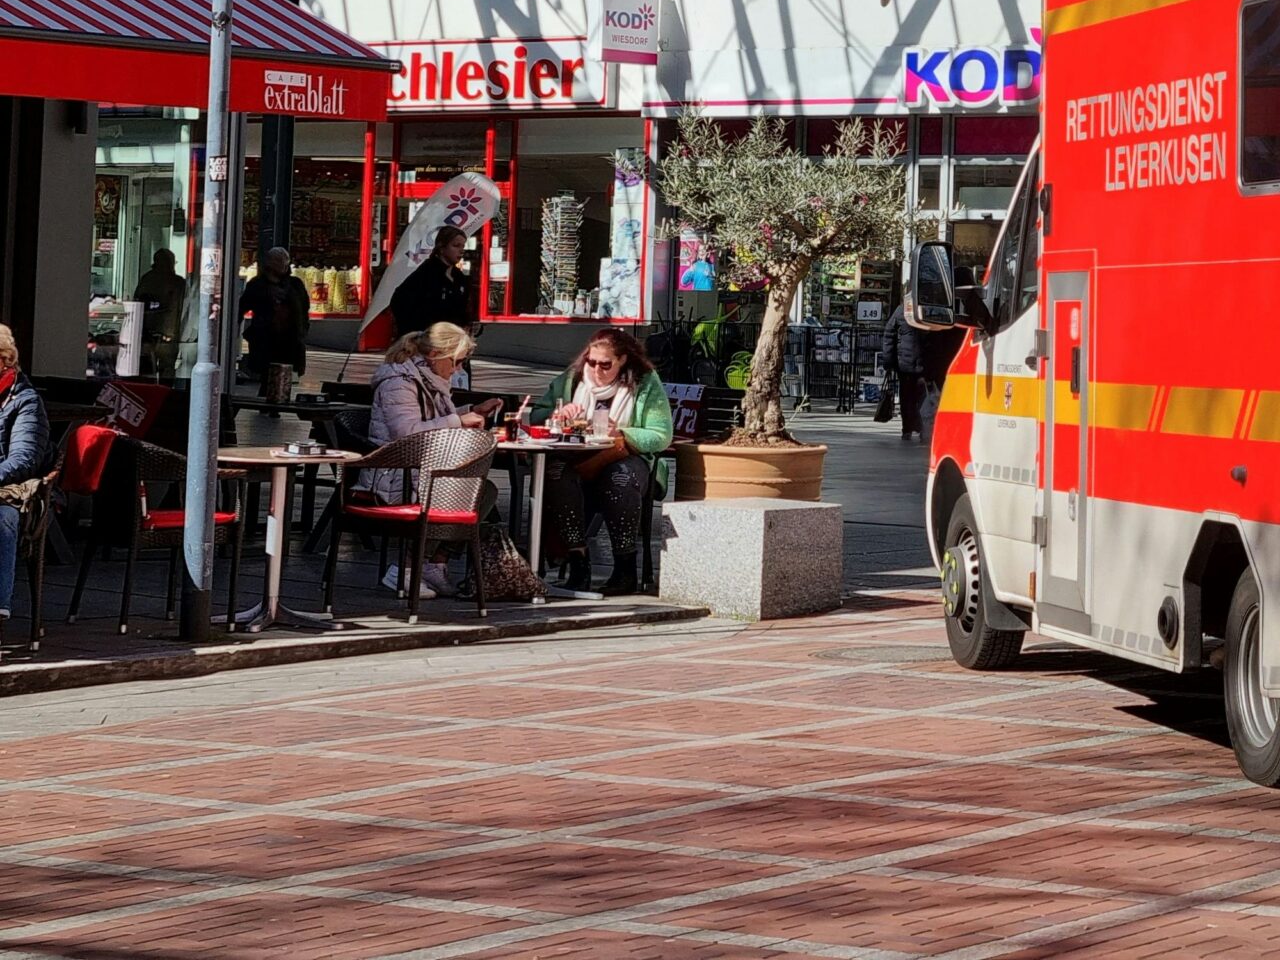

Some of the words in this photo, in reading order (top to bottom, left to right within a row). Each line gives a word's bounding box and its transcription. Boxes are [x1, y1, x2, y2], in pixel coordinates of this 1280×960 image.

[611, 34, 649, 46] WIESDORF
[266, 73, 305, 84] CAFE
[389, 46, 585, 101] chlesier
[904, 49, 1041, 104] KOD
[264, 75, 349, 115] extrablatt
[1066, 71, 1227, 143] RETTUNGSDIENST
[1105, 131, 1227, 193] LEVERKUSEN
[862, 310, 878, 318] 3.49
[664, 384, 703, 398] AFE
